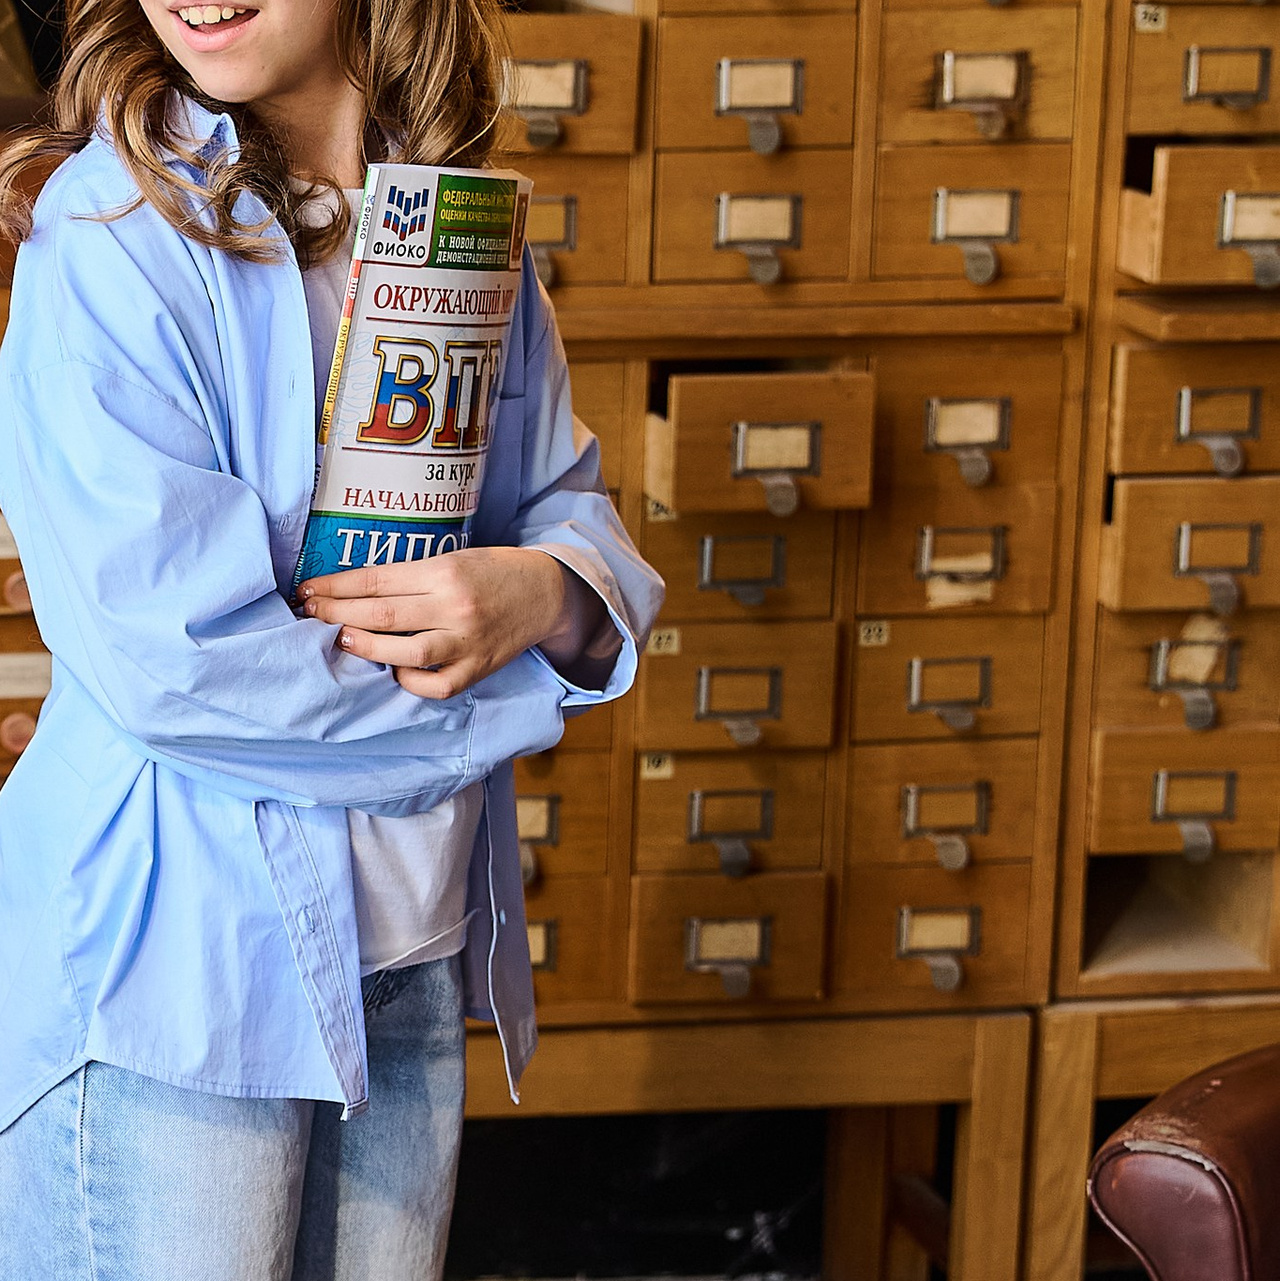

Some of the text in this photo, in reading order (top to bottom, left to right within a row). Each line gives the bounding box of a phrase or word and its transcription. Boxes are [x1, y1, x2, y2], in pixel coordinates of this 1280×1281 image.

[360, 206, 372, 240] ФИОКО
[440, 209, 467, 222] ОЦЕНКИ
[373, 241, 426, 259] ФИОКО
[438, 235, 446, 248] К
[448, 235, 475, 250] НОВОЙ
[348, 277, 359, 300] ВПР
[373, 284, 501, 321] ОКРУЖАЮЩИЙ
[321, 324, 348, 432] ОКРУЖАЮЩИЙ МИР
[425, 462, 476, 487] за курс
[342, 487, 466, 512] НАЧАЛЬНОЙ
